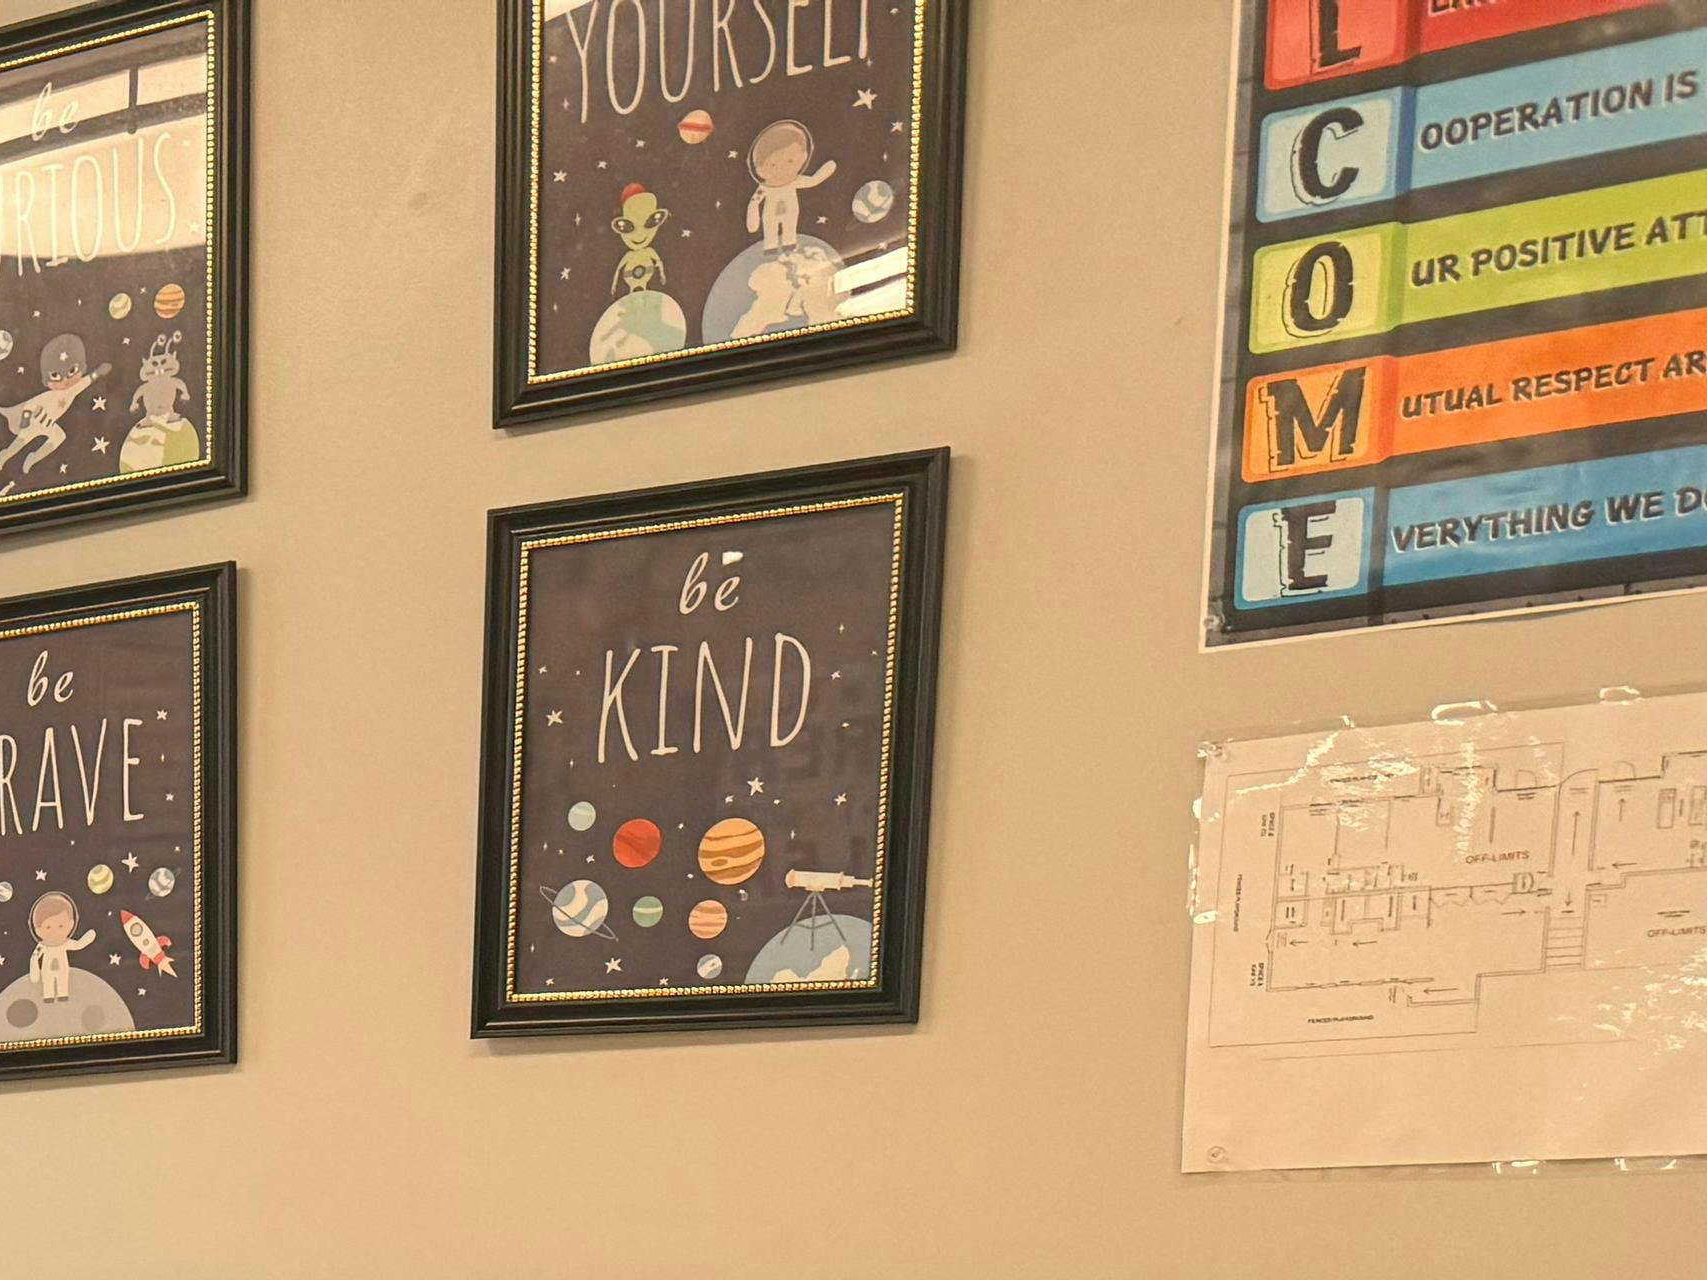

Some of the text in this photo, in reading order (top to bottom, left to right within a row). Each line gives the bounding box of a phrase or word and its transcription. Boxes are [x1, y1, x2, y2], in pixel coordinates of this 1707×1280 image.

[31, 81, 80, 142] be
[1291, 69, 1699, 205] C OOPERATION IS
[1285, 240, 1355, 337] O
[1410, 254, 1462, 288] UR
[1471, 222, 1637, 277] POSITIVE
[1261, 366, 1368, 473] M
[1401, 383, 1504, 420] UTUAL
[1510, 355, 1656, 401] RESPECT
[678, 550, 741, 615] be
[1275, 500, 1337, 597] E
[1390, 500, 1595, 553] VERYTHING
[1604, 490, 1665, 525] WE
[26, 649, 74, 707] be
[597, 632, 812, 764] KIND
